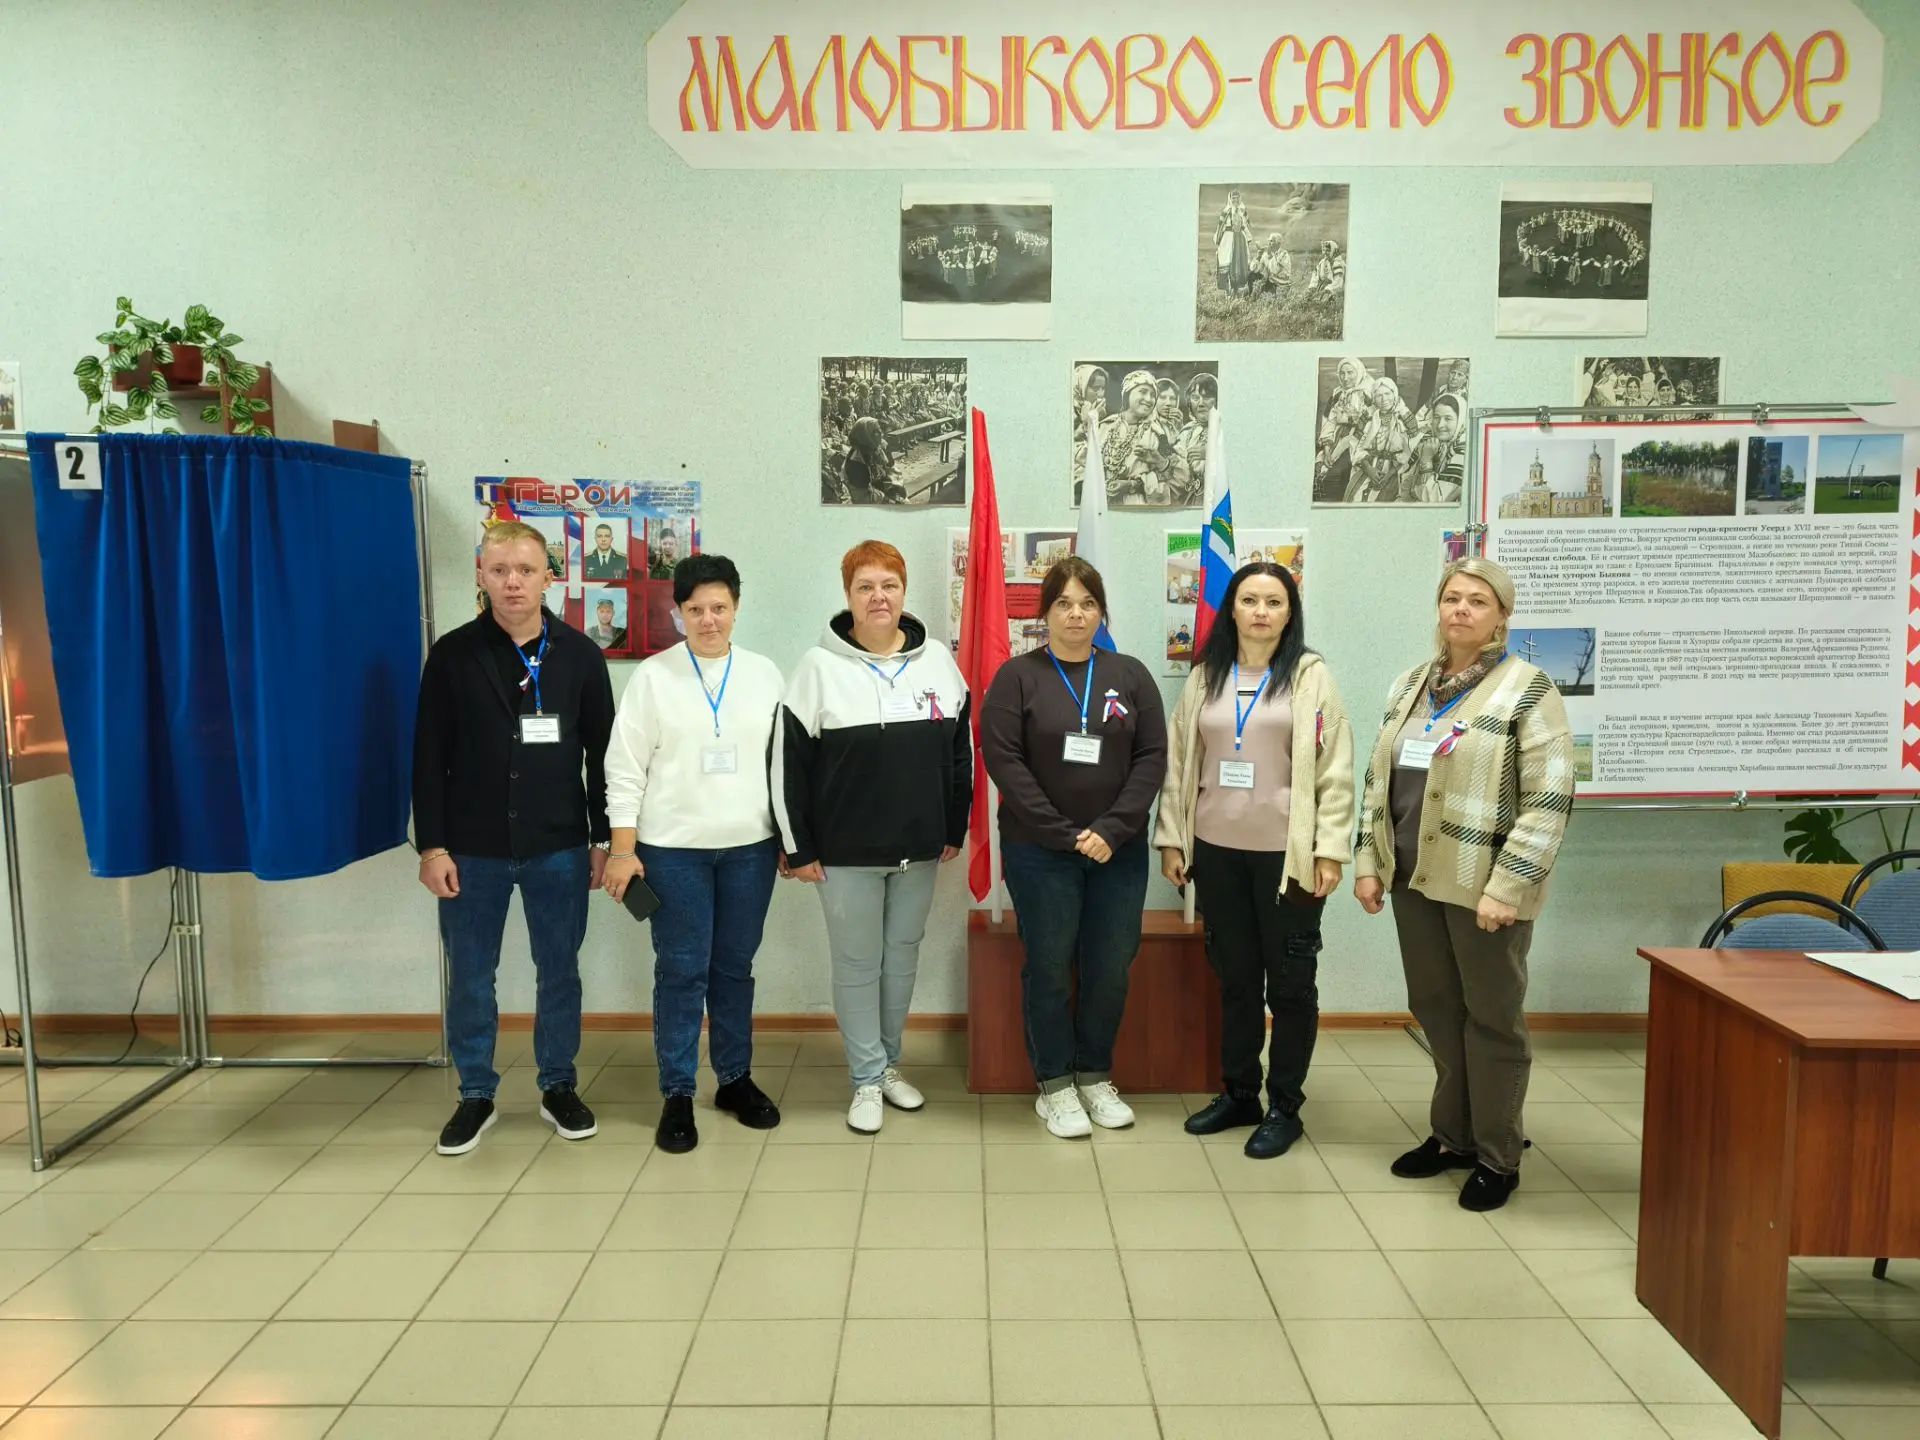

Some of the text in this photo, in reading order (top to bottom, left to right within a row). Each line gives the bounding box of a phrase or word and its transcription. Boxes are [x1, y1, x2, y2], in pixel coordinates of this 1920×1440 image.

[66, 446, 86, 480] 2
[514, 482, 632, 506] ГЕРОИ
[1667, 656, 1683, 664] 1887
